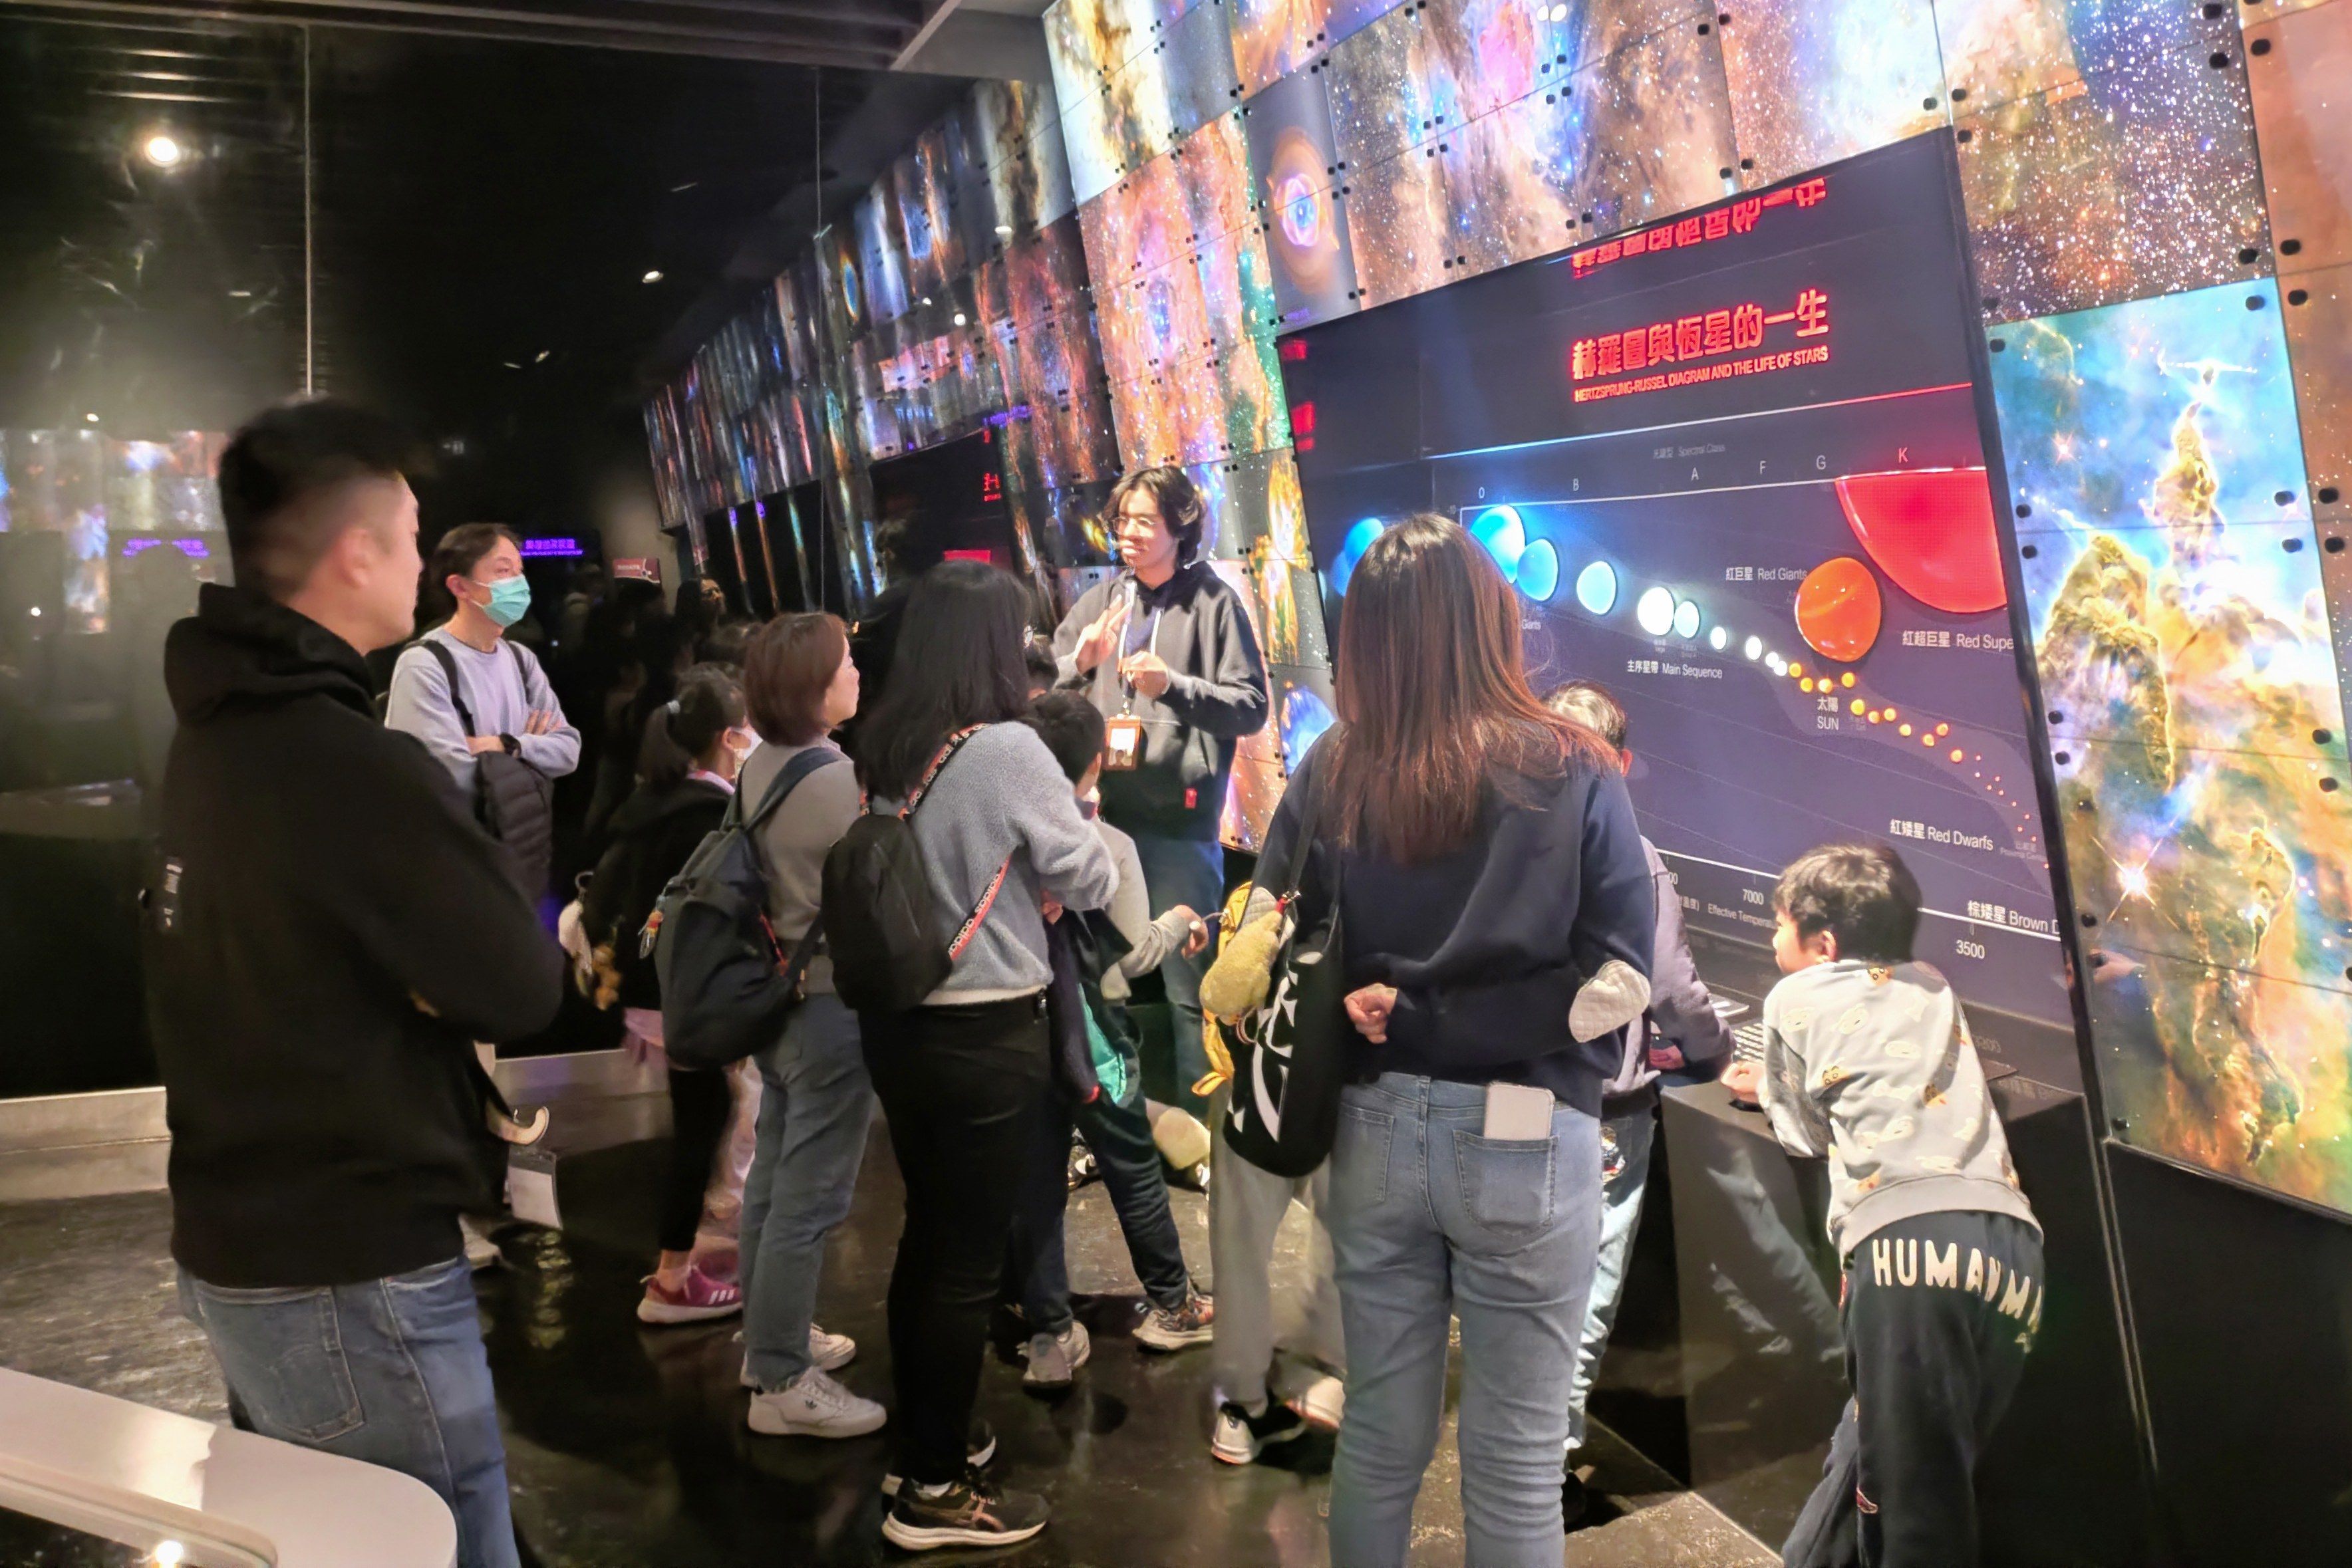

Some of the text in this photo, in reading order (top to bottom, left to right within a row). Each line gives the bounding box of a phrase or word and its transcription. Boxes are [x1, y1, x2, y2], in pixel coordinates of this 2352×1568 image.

[1574, 346, 1829, 402] HERTZSPRUNG-RUSSEL DIAGRAM AND THE LIFE OF STARS
[1572, 477, 1580, 491] B
[1691, 467, 1699, 481] A
[1759, 461, 1767, 475] F
[1817, 455, 1826, 470] G
[1898, 447, 1908, 463] K
[1725, 567, 1808, 581] 紅巨星 Red Giants
[1902, 630, 1951, 648] 紅超巨星
[1956, 633, 1980, 648] Red
[1662, 663, 1681, 676] Main
[1682, 664, 1723, 679] Sequence
[1817, 696, 1838, 713] 太陽
[1817, 716, 1839, 731] SUN
[1890, 819, 1993, 851] 紅矮星 Red Dwarfs
[974, 873, 1000, 914] adidas
[1743, 888, 1764, 906] 7000
[1707, 903, 1737, 919] Effective
[2009, 910, 2048, 932] Brown
[1956, 939, 1985, 960] 3500
